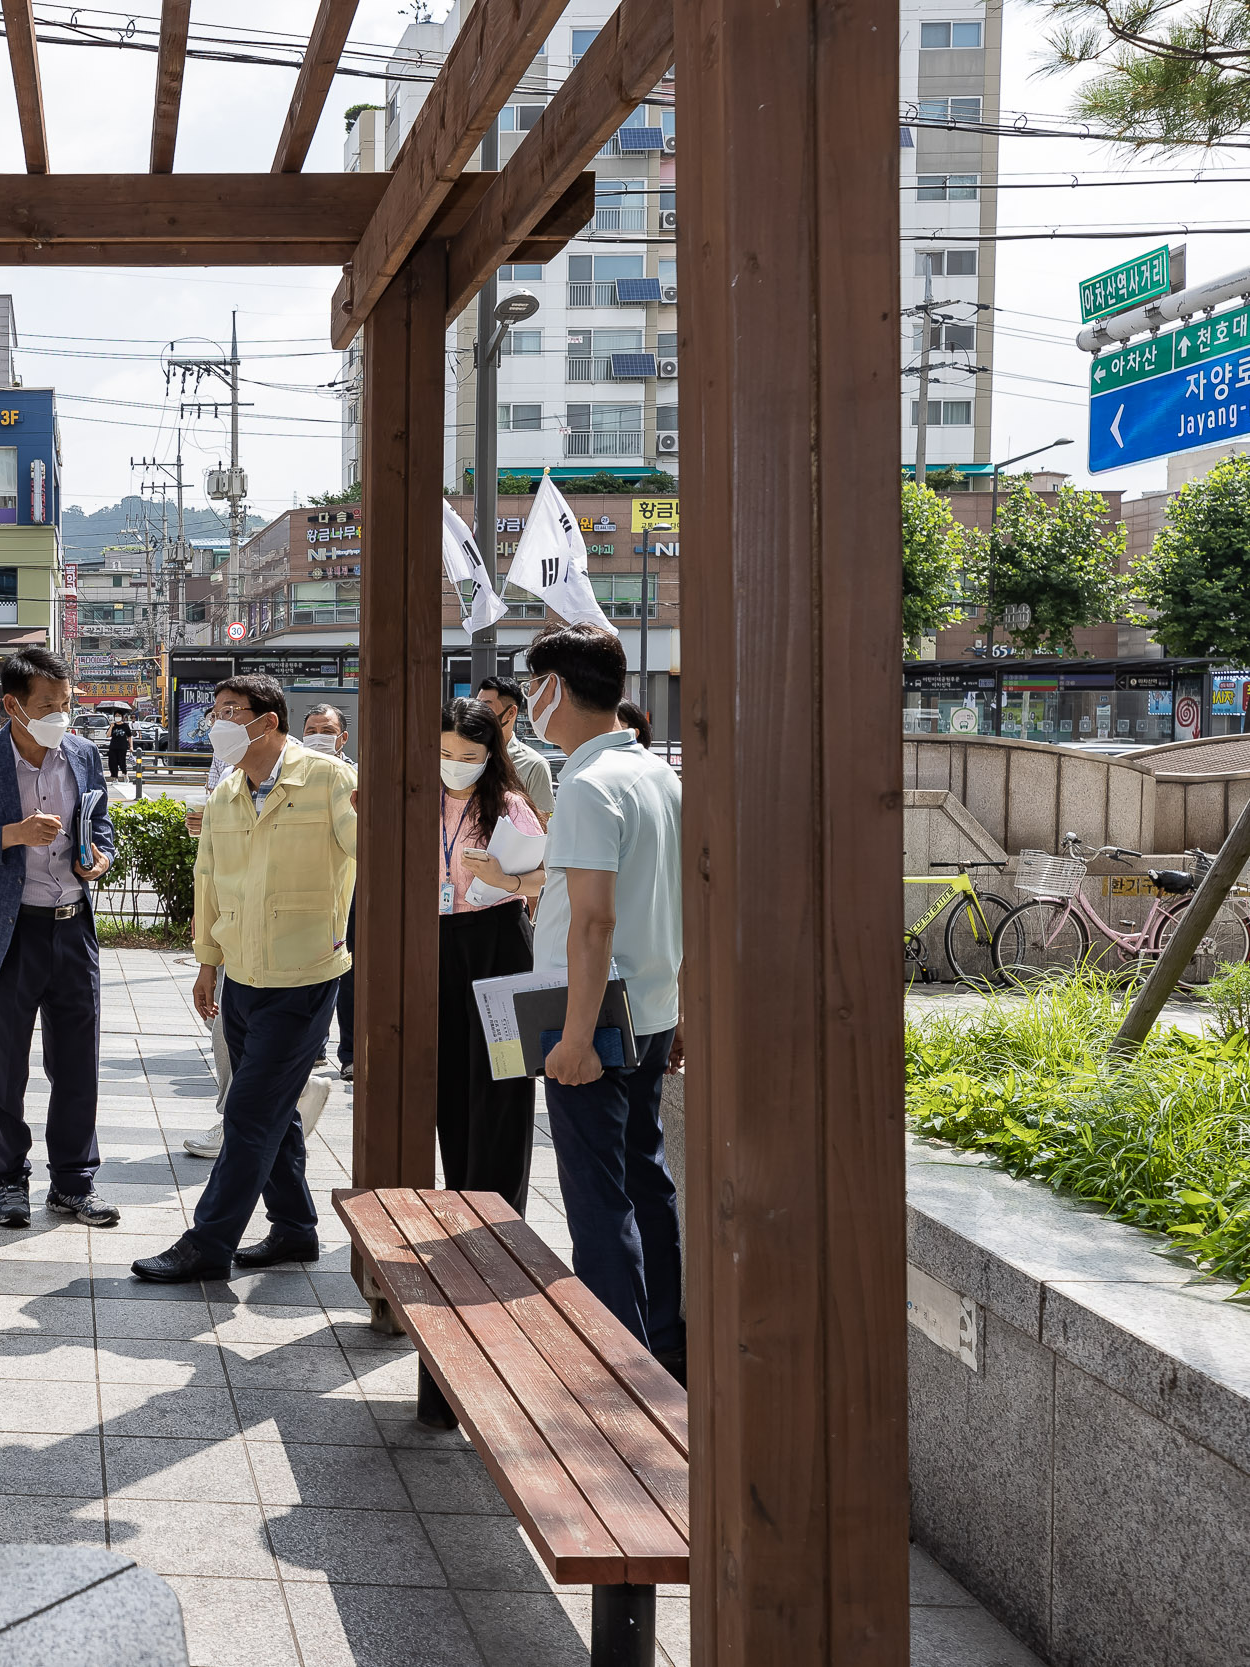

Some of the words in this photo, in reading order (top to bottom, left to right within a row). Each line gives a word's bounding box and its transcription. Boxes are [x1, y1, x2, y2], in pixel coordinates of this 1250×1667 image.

[1084, 255, 1164, 313] 아차산역사거리
[1111, 345, 1158, 377] 아차산
[0, 410, 20, 426] 3F
[306, 525, 356, 543] 황금나무
[307, 547, 337, 562] NH
[586, 543, 615, 555] 아과
[231, 627, 243, 636] 30
[180, 687, 196, 704] TIM
